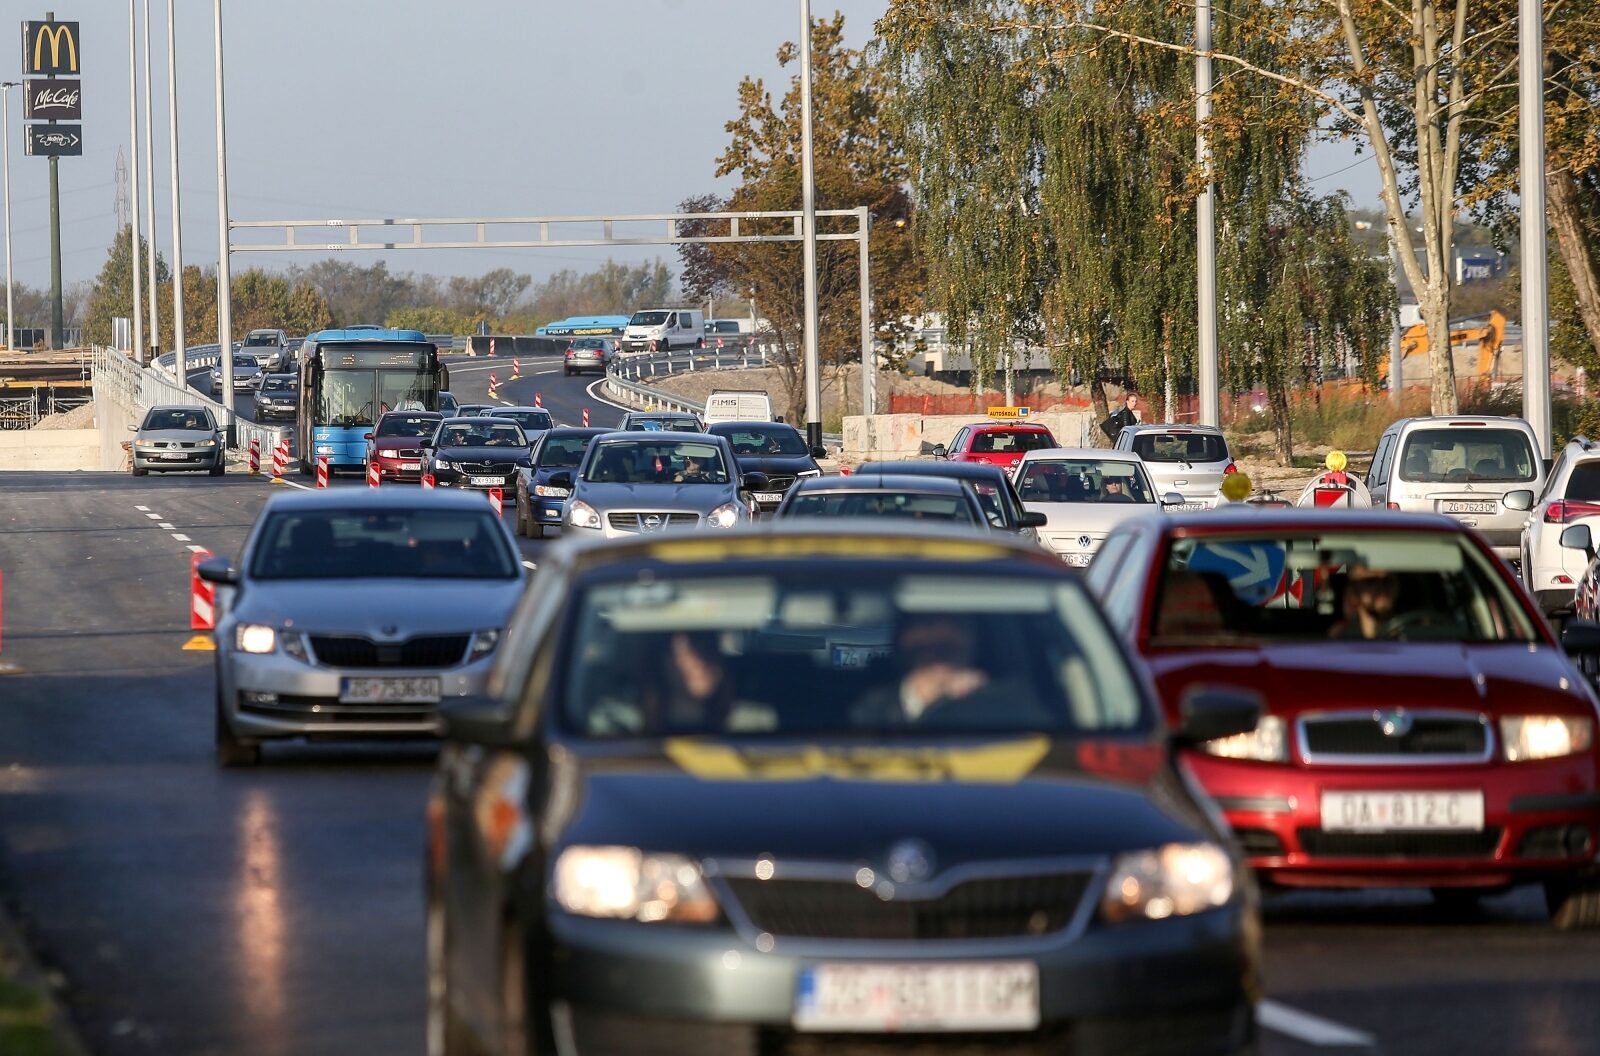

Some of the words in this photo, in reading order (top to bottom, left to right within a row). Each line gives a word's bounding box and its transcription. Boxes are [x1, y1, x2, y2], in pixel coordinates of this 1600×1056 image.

[34, 88, 78, 109] McCafé
[1449, 503, 1459, 511] ZG
[1465, 503, 1496, 512] 7623-DM
[1064, 555, 1073, 564] ZG
